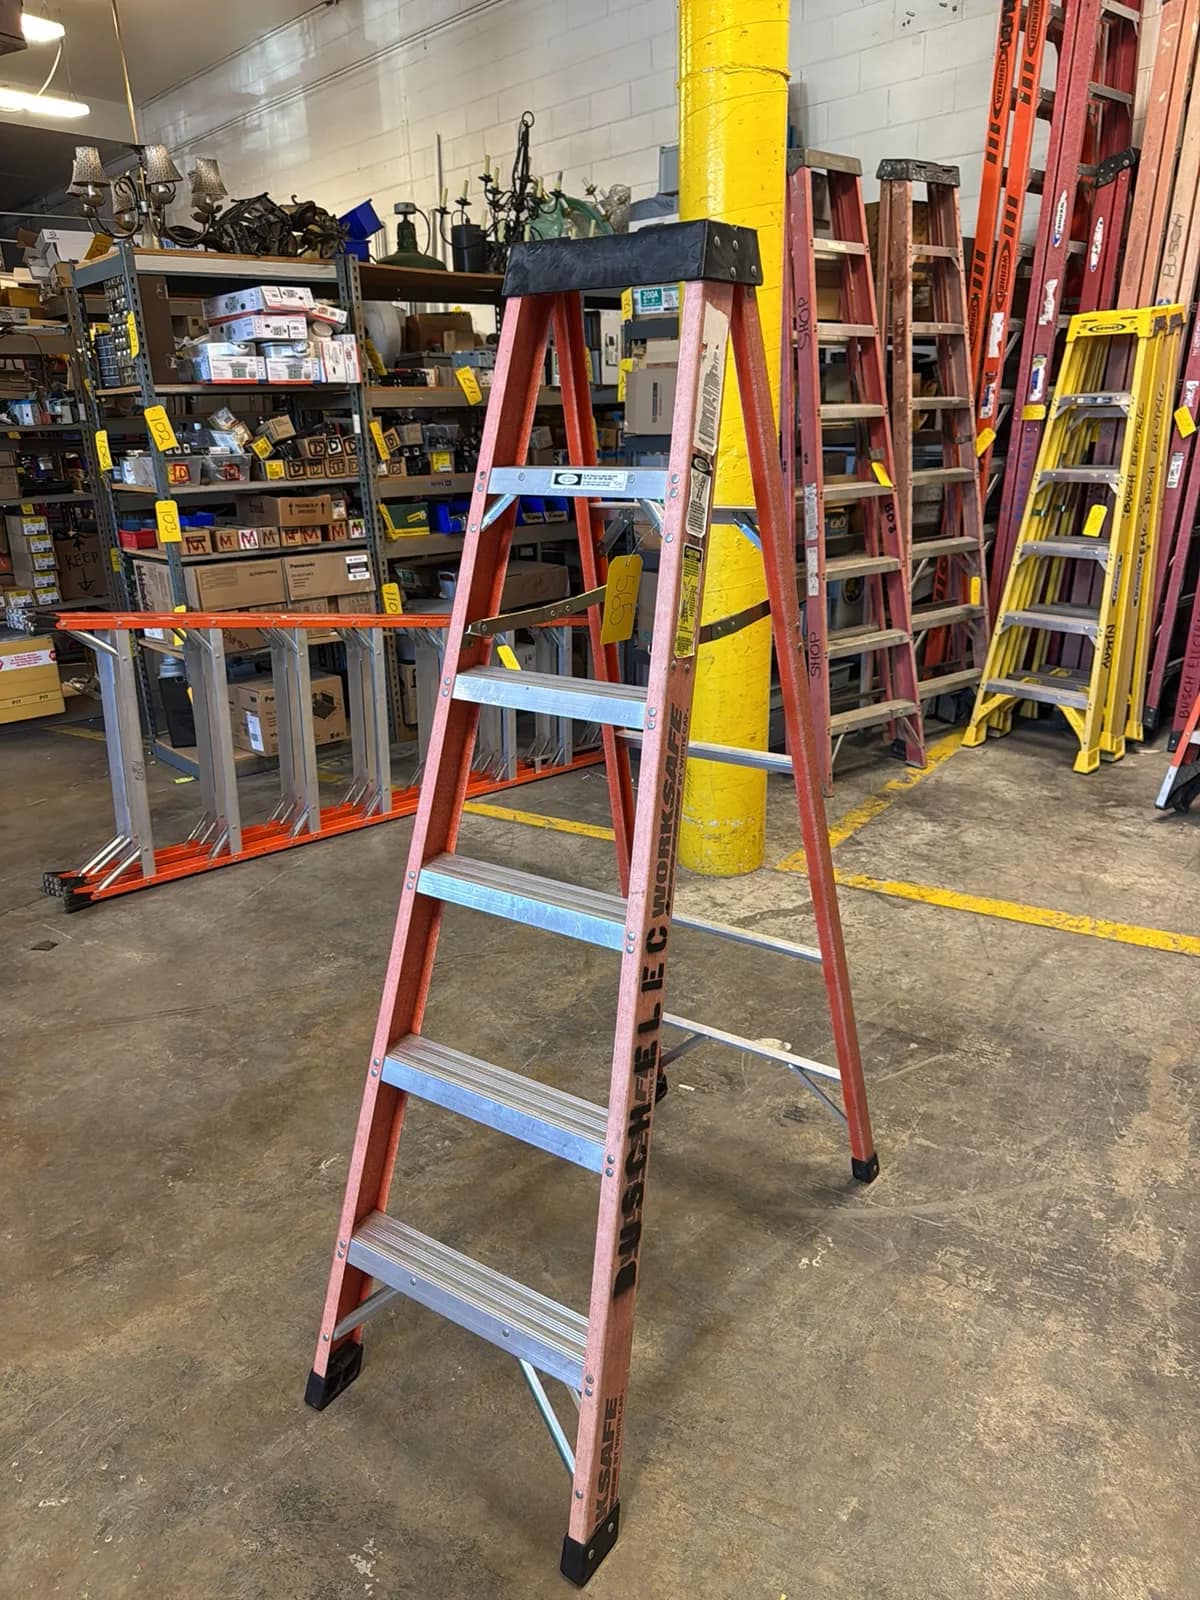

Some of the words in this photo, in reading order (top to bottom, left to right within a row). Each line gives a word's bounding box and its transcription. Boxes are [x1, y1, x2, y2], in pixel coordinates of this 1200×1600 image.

[797, 297, 809, 350] SHOP
[150, 417, 170, 444] 102
[159, 510, 177, 533] 103
[331, 524, 344, 541] M
[220, 535, 232, 548] M
[241, 530, 257, 546] M
[263, 530, 275, 544] M
[303, 528, 319, 542] M
[385, 592, 400, 613] 110
[610, 576, 635, 626] 565
[810, 632, 822, 680] SHOP
[1178, 676, 1193, 719] BUSCH
[652, 703, 683, 918] WORKSAFE
